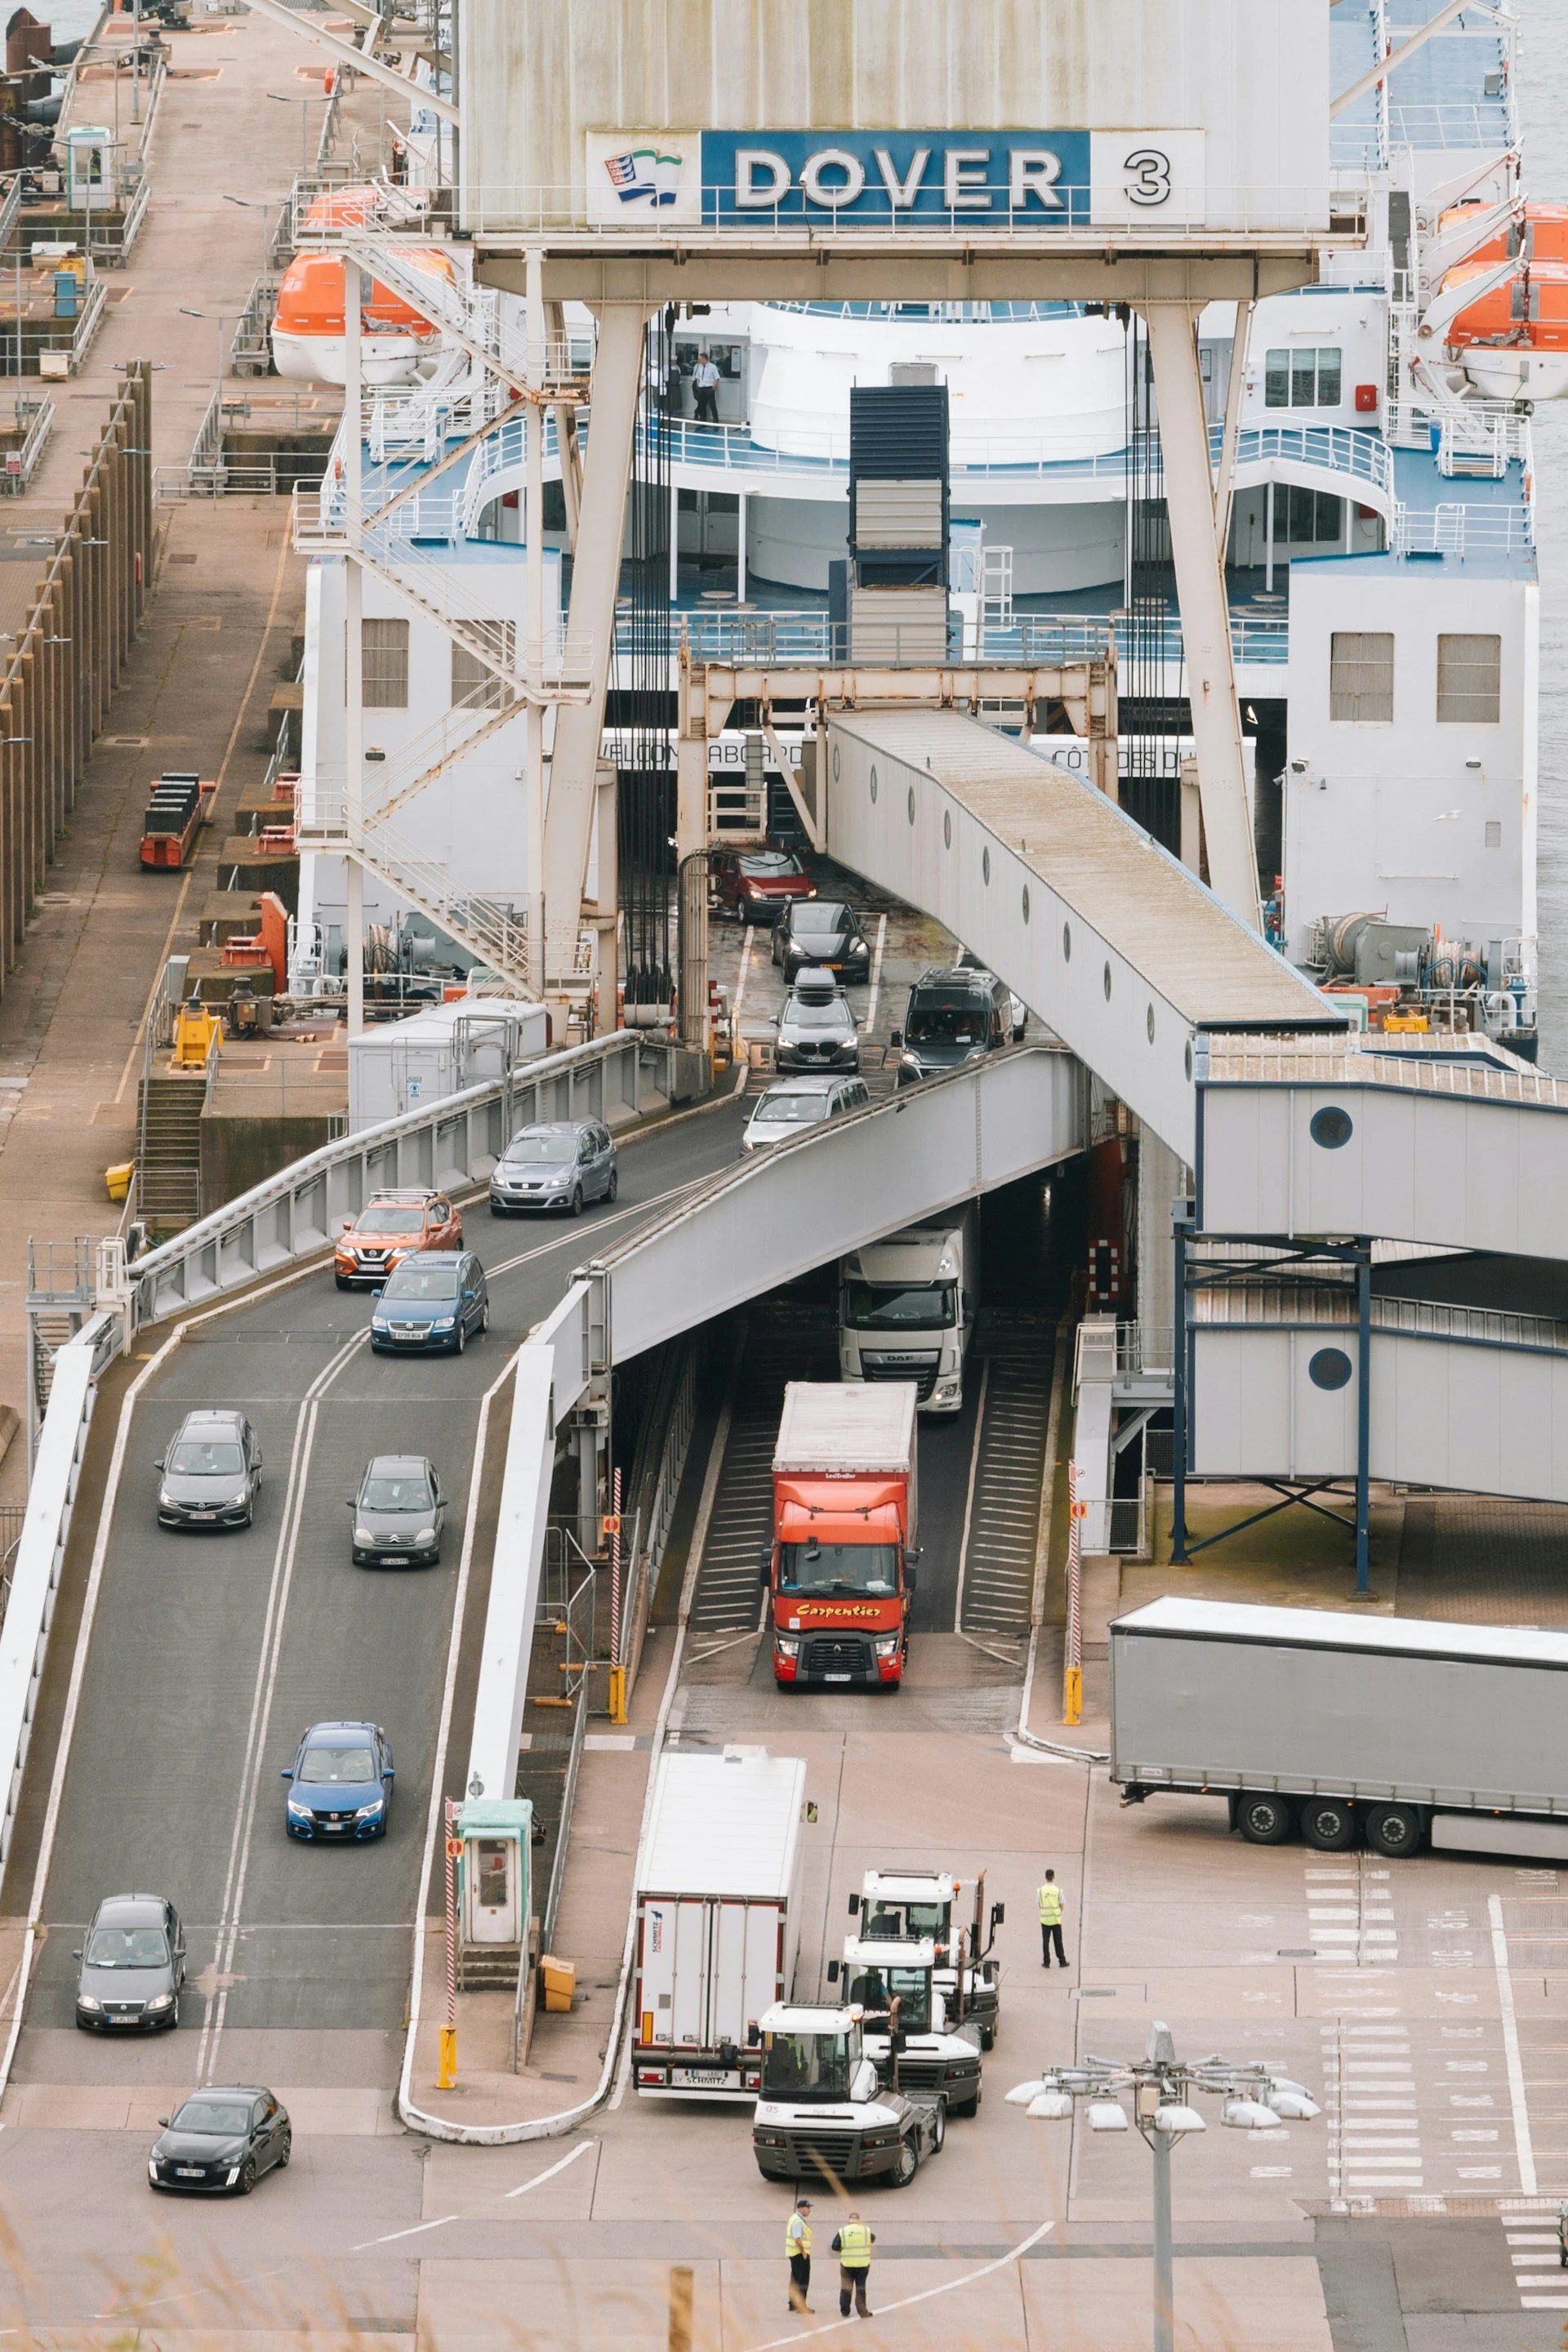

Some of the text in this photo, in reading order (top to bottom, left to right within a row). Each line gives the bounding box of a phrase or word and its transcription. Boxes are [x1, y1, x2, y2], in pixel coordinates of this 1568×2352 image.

[733, 149, 1172, 208] DOVER 3
[795, 1603, 881, 1619] Carpentier
[686, 2077, 726, 2085] SCHMITZ
